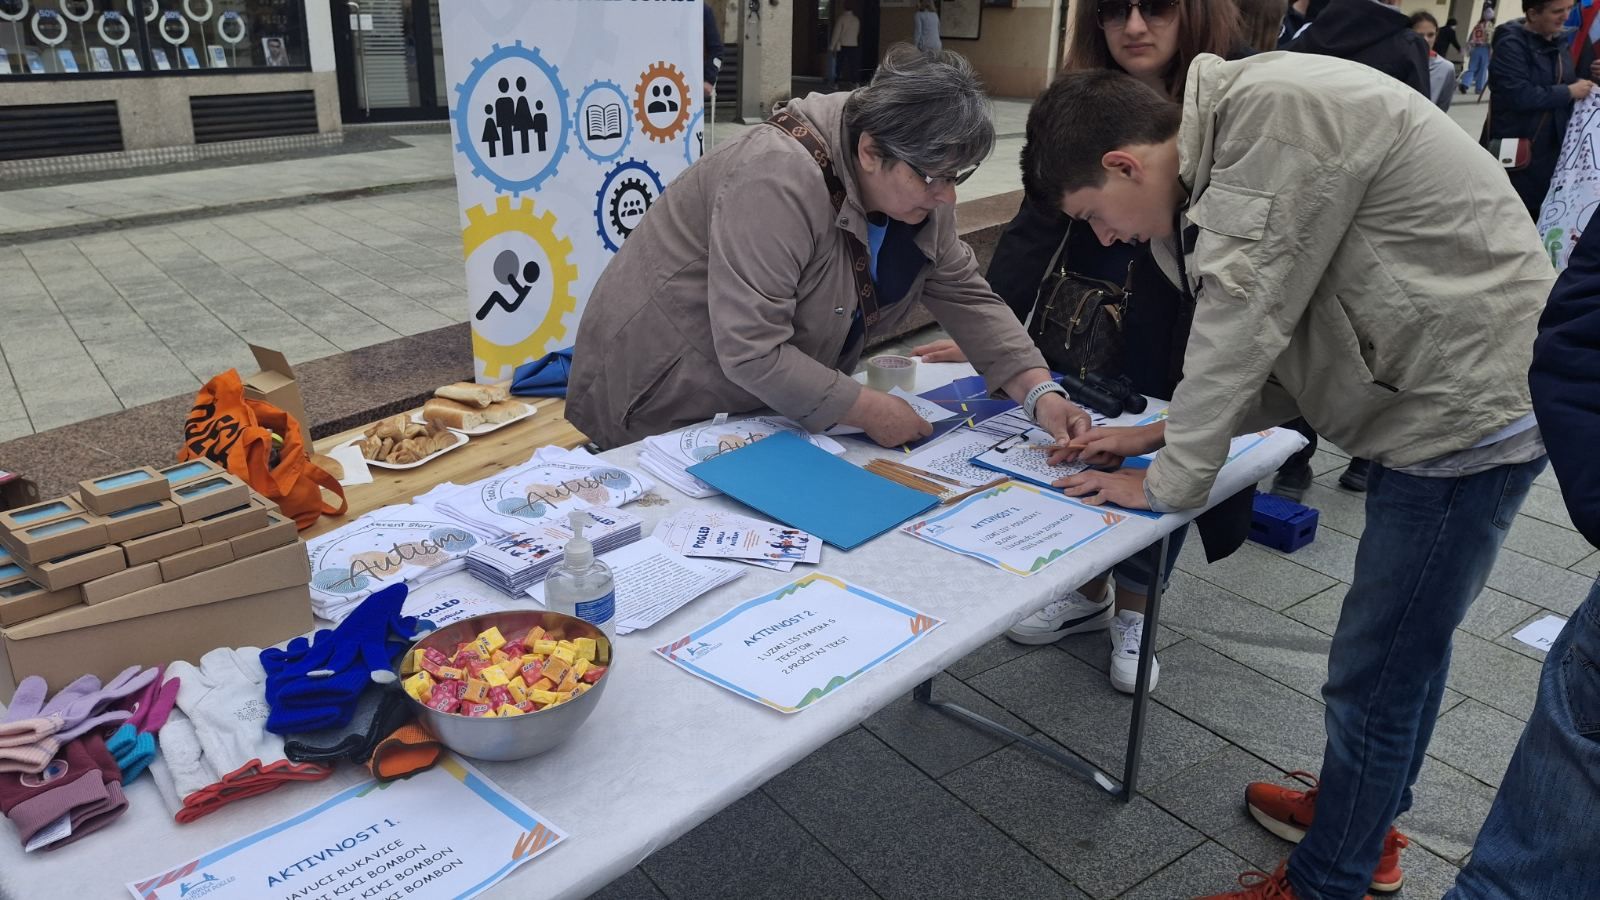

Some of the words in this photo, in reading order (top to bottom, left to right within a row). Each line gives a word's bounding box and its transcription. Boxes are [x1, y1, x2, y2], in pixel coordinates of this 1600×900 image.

[511, 471, 621, 515] Autism
[693, 527, 711, 549] POGLED
[326, 532, 467, 589] Autism
[743, 613, 805, 647] AKTIVNOST
[824, 635, 850, 650] TEKST
[268, 823, 380, 888] AKTIVNOST
[383, 818, 401, 828] 1.
[332, 876, 367, 897] KIKI
[366, 843, 427, 879] BOMBON
[336, 838, 405, 877] RUKAVICE
[361, 879, 395, 900] KIKI
[394, 846, 454, 882] BOMBON
[403, 858, 464, 894] BOMBON
